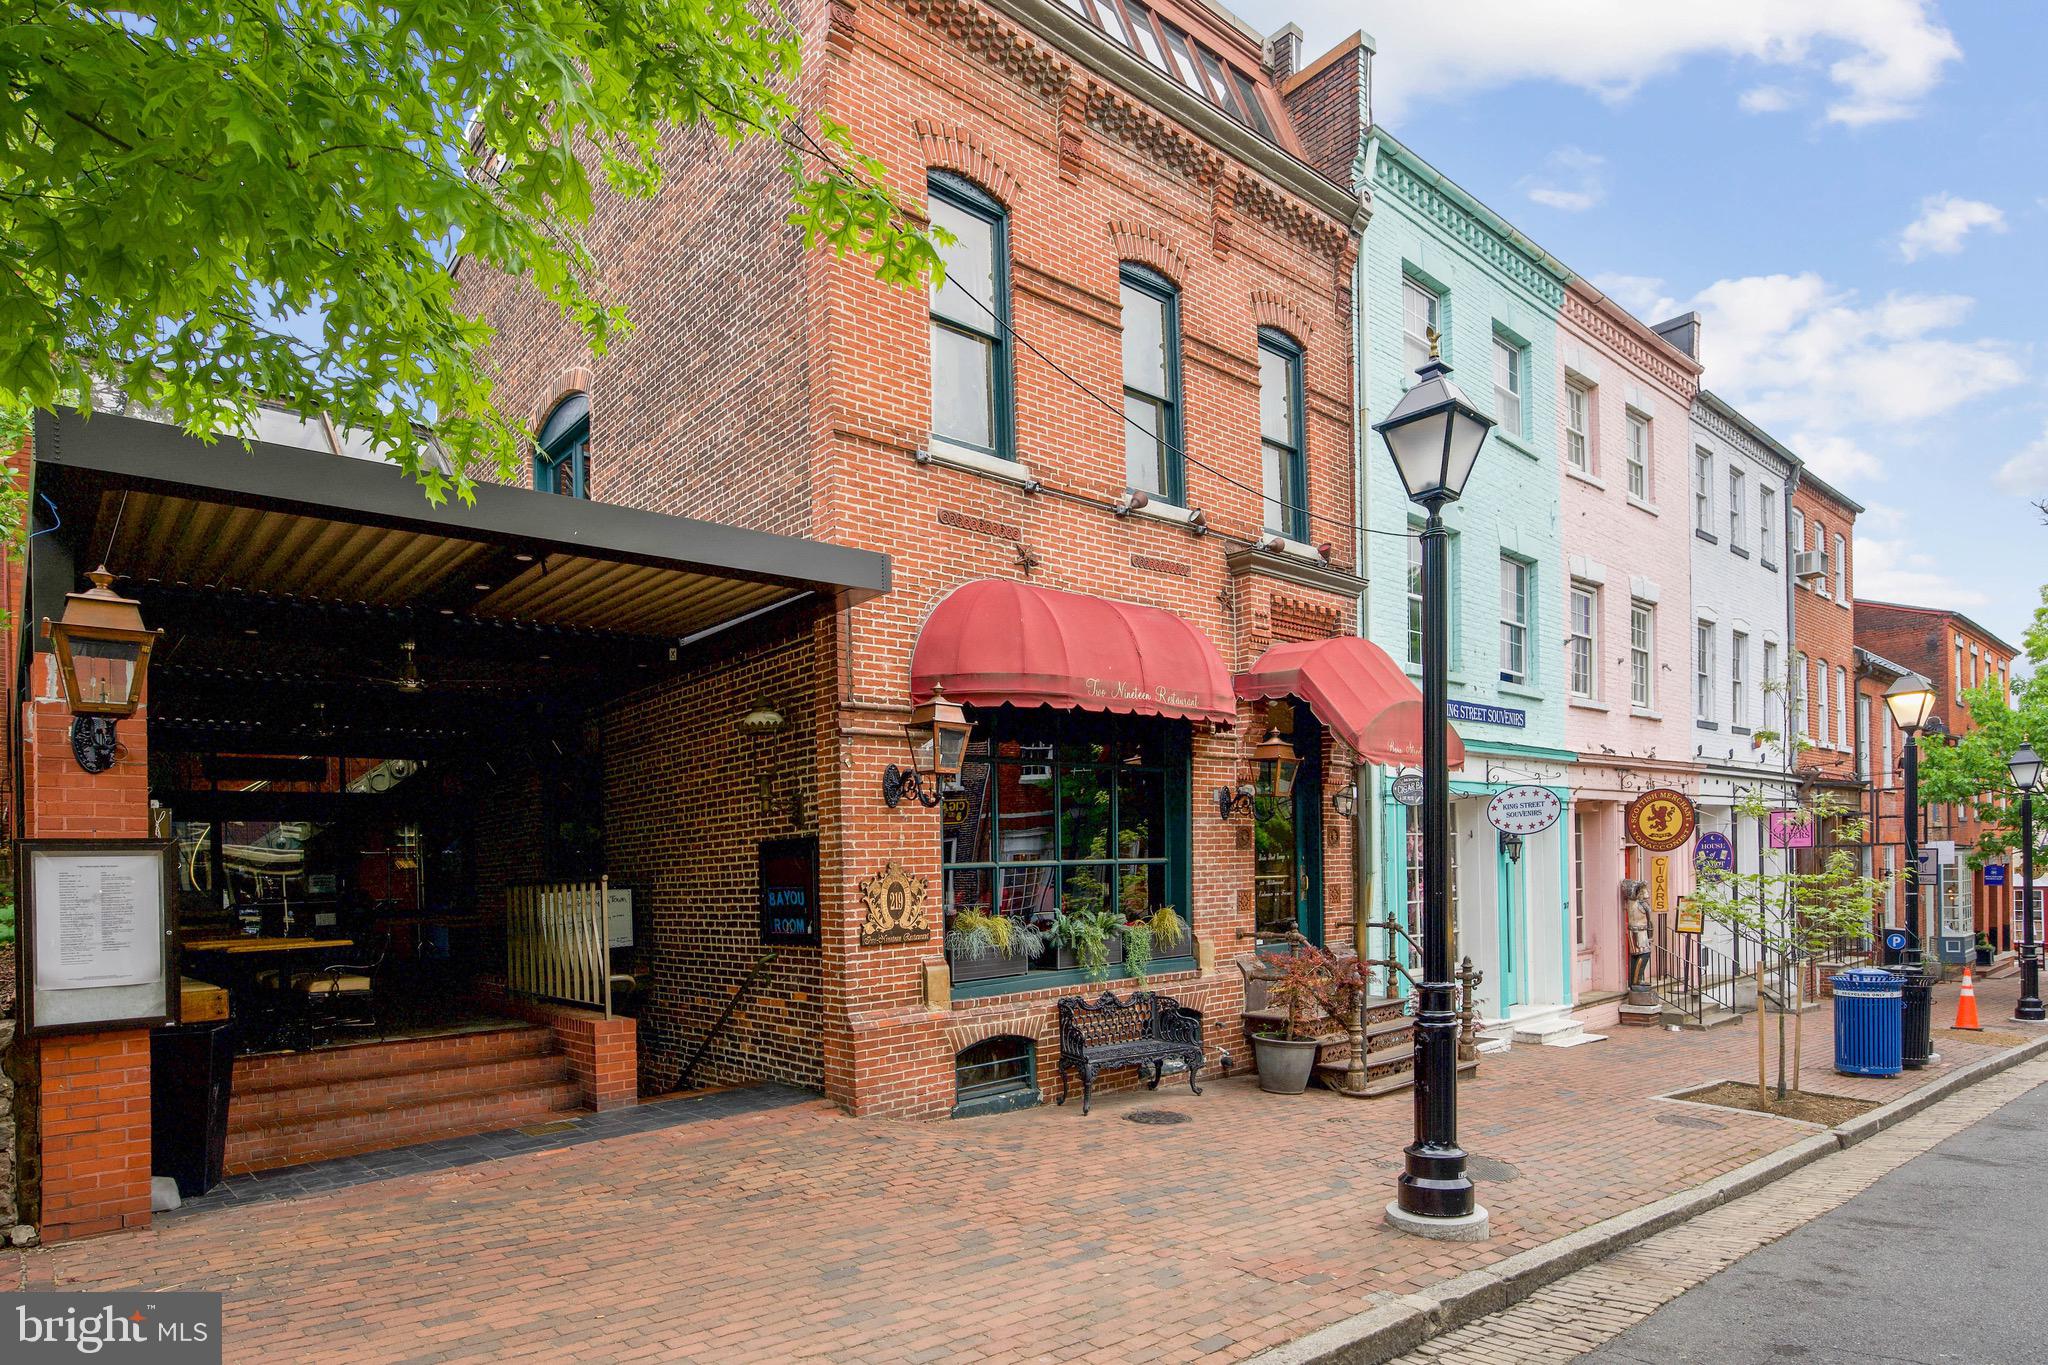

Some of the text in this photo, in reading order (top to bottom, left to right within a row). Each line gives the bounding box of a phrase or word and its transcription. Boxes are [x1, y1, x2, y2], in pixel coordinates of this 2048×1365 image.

[1086, 677, 1199, 707] Two Nineteen Restaurant
[1447, 703, 1524, 727] ING STREET SOUVENIRS
[1502, 800, 1545, 811] KING STREET
[1506, 809, 1543, 818] SOUVENIRS
[1631, 792, 1692, 825] SCOTTISH MERCHANT
[1633, 826, 1689, 849] TOBACCONIST
[1655, 857, 1665, 910] CIGARS
[769, 890, 805, 906] BAYOU
[889, 891, 904, 911] 219
[774, 918, 805, 933] ROOM
[1892, 936, 1901, 947] P
